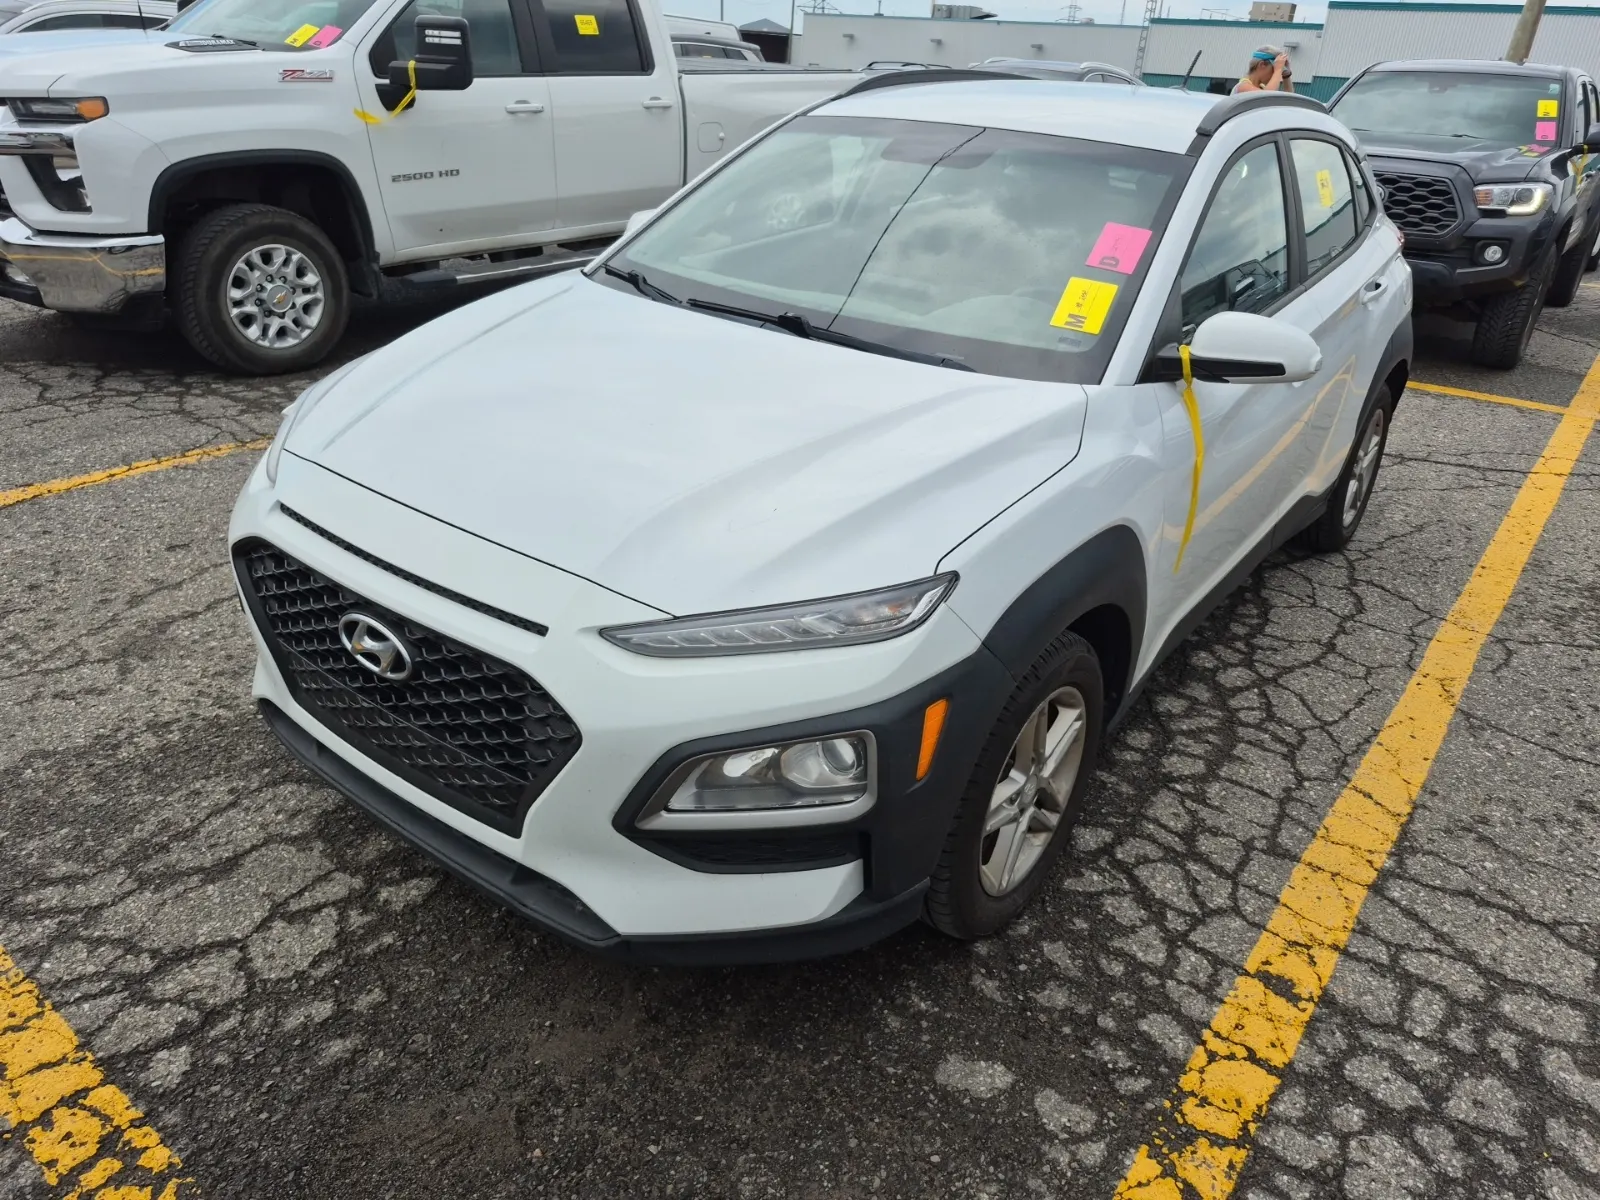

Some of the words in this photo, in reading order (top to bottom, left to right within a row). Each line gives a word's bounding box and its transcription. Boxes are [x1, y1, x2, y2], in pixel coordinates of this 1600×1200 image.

[391, 172, 434, 183] 2500
[438, 168, 460, 178] HD
[1099, 256, 1120, 269] D
[1064, 313, 1087, 328] M
